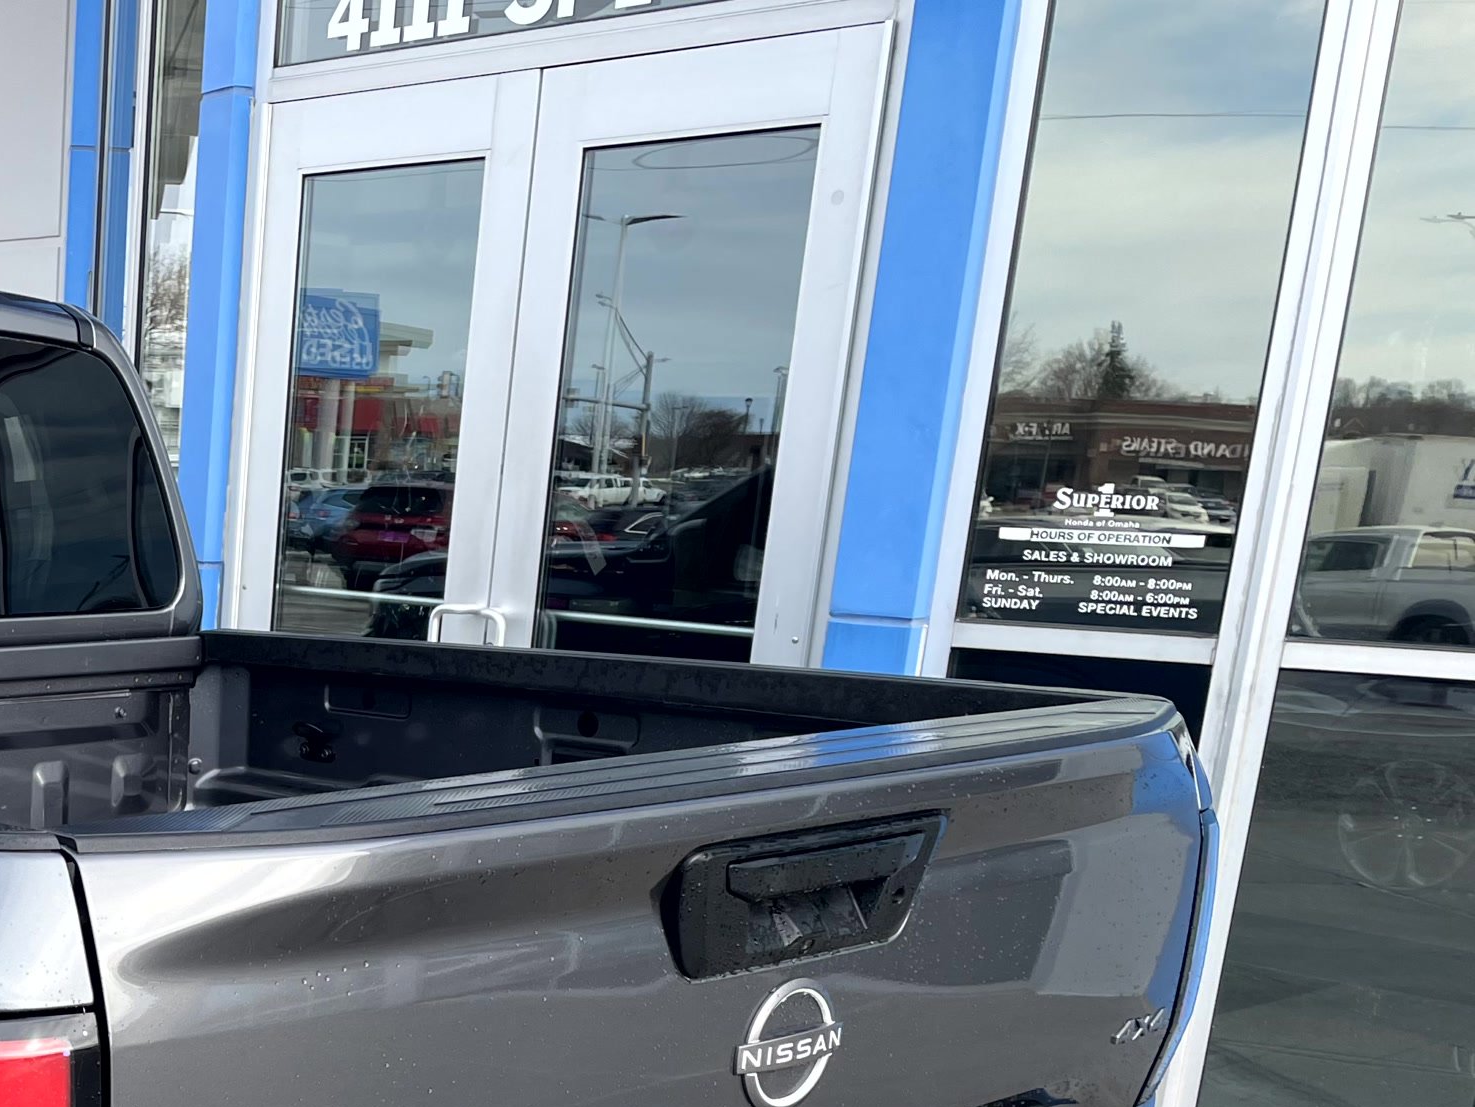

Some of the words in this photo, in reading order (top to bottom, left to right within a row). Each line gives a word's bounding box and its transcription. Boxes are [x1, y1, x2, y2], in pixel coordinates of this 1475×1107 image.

[1065, 518, 1094, 528] Honda
[1096, 519, 1106, 528] of
[1107, 519, 1140, 529] Omaha
[1030, 529, 1074, 542] HOURS
[1077, 531, 1093, 542] OF
[1096, 531, 1172, 545] OPERATION
[1022, 549, 1067, 563] SALES
[1070, 552, 1081, 563] &
[1084, 552, 1173, 567] SHOWROOM
[985, 569, 1019, 582] Mon.
[1032, 571, 1075, 585] Thurs.
[983, 583, 1005, 595] Fri.
[1017, 585, 1043, 598] Sat.
[982, 597, 1040, 610] SUNDAY
[1078, 602, 1137, 617] SPECIAL
[1141, 606, 1198, 620] EVENTS
[739, 1027, 843, 1070] NISSAN
